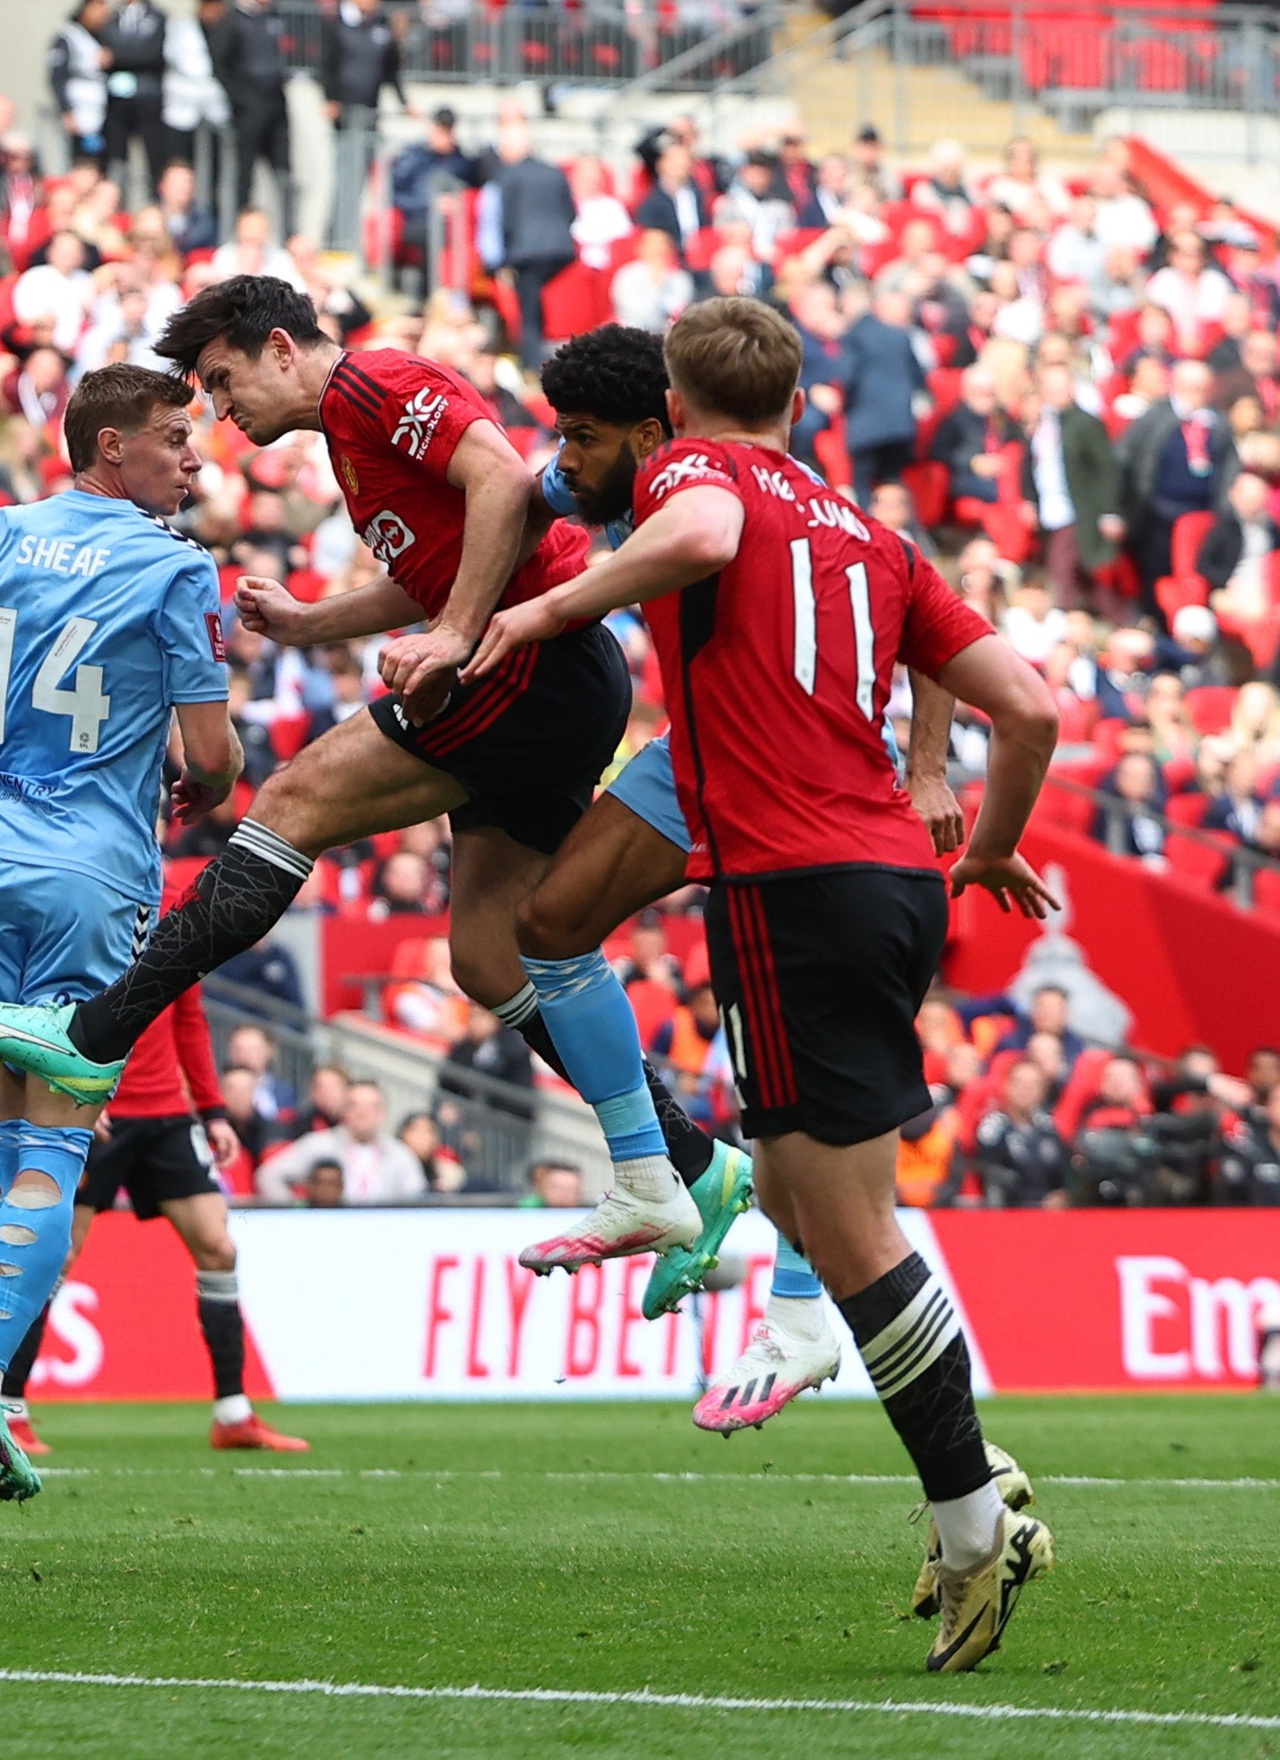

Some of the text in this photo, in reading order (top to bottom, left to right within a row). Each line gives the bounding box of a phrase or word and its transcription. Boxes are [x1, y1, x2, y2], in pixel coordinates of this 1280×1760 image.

[391, 386, 443, 457] DXC
[415, 396, 450, 461] TECHNOLOGY
[15, 534, 111, 577] SHEAF
[789, 537, 876, 722] 11
[422, 1256, 536, 1377] FLY
